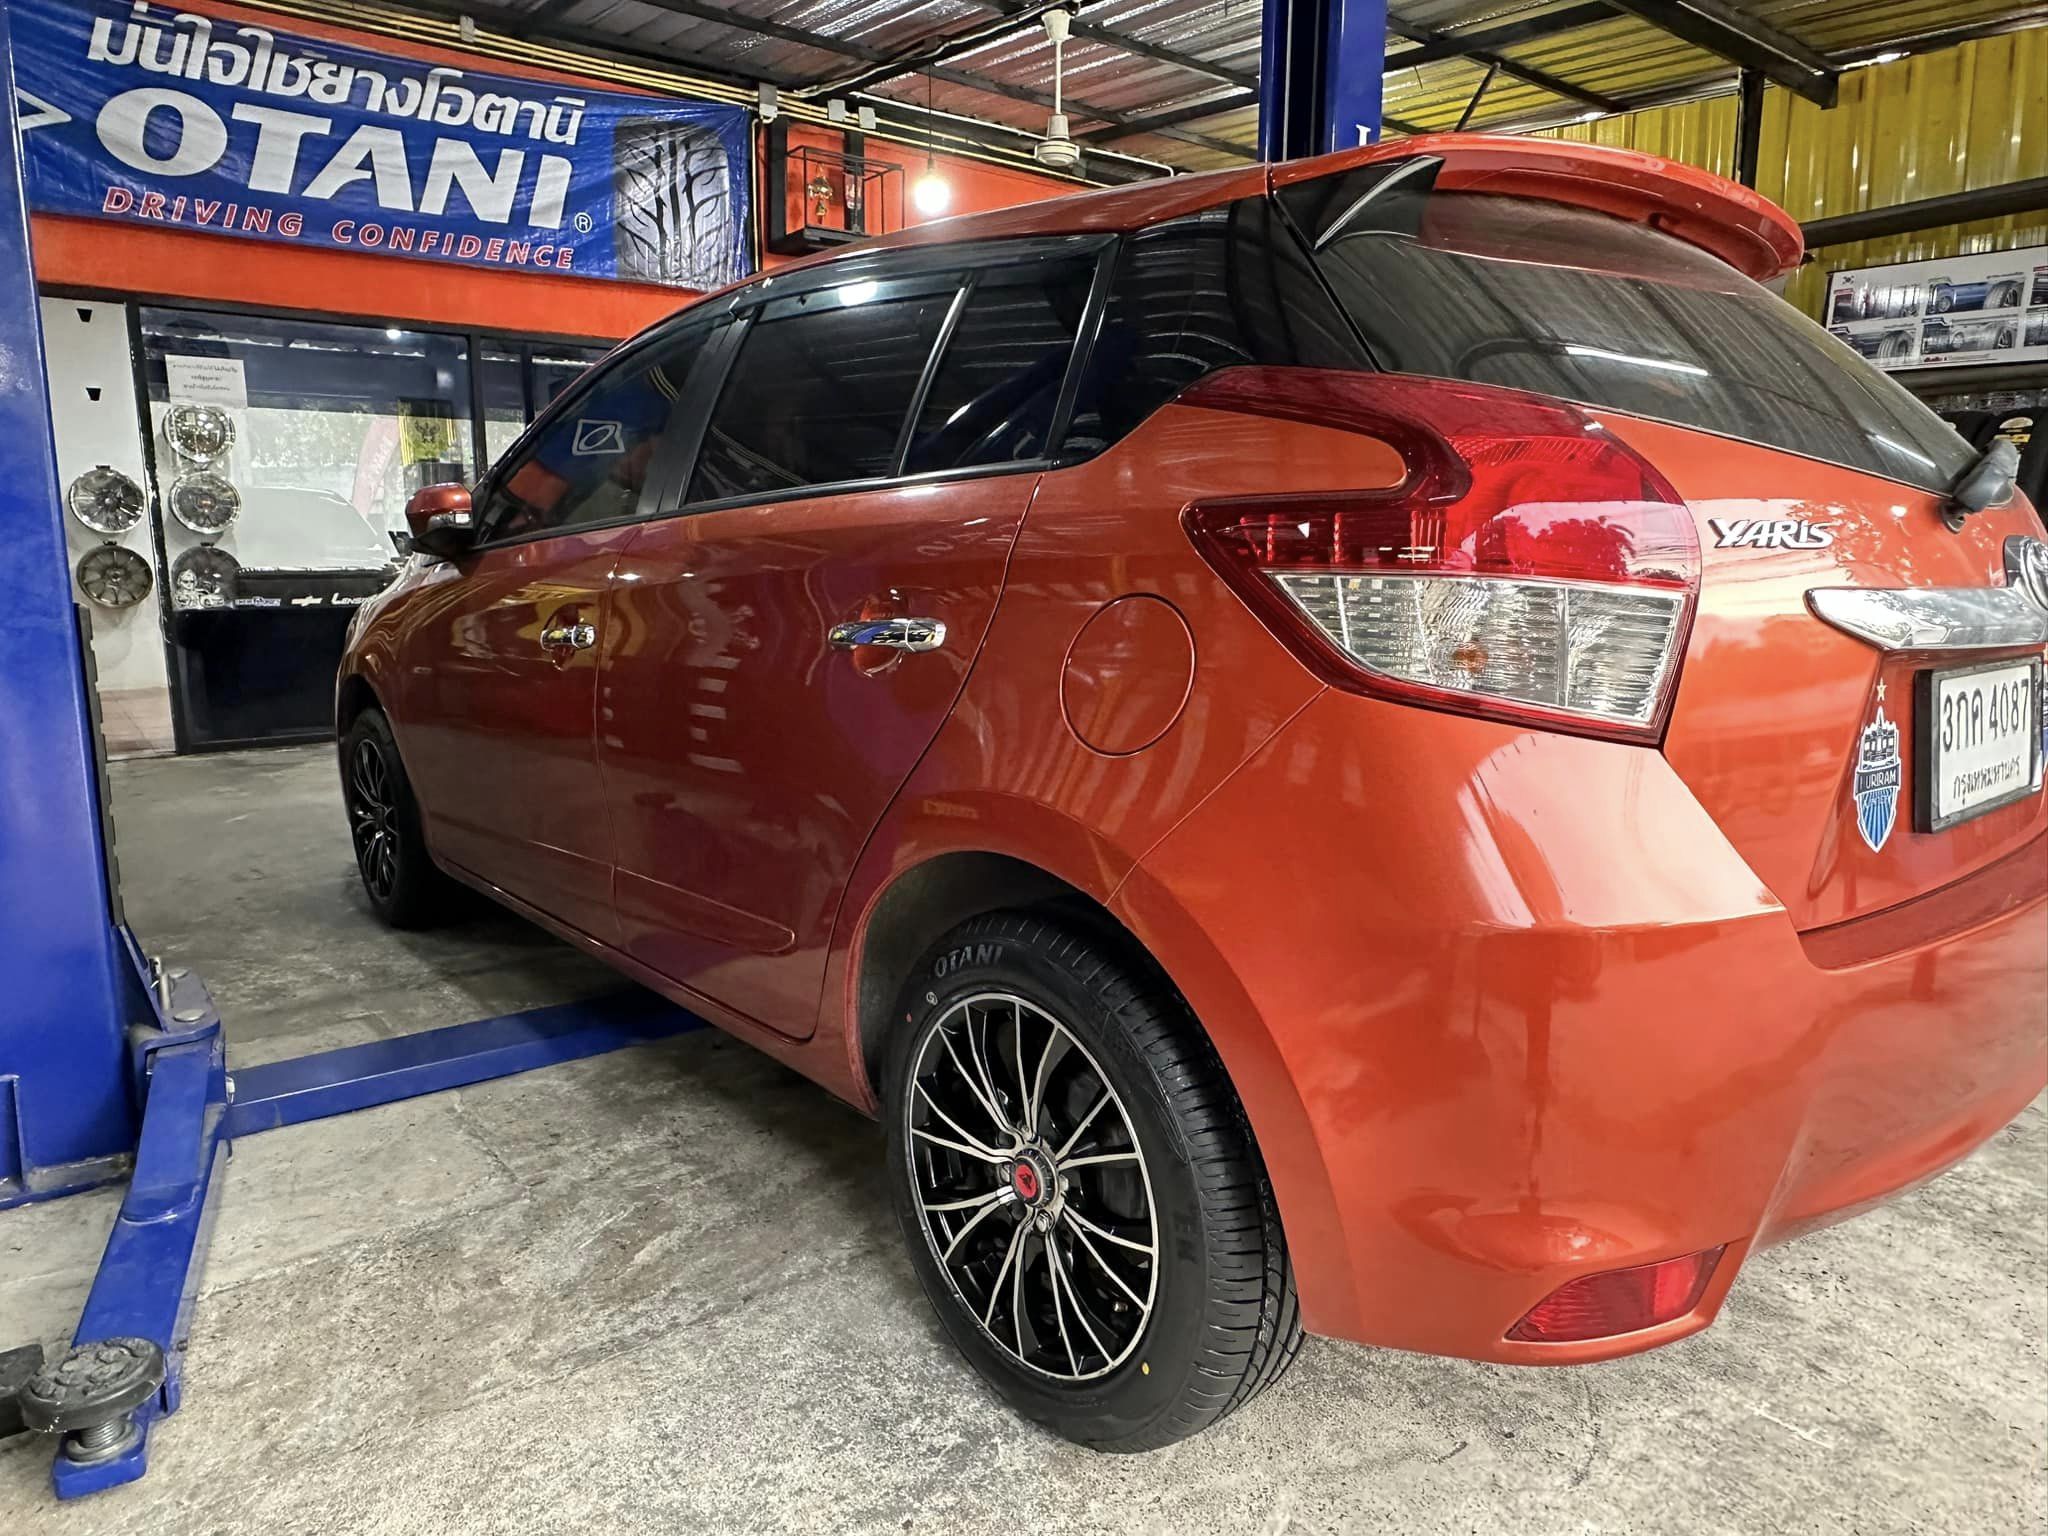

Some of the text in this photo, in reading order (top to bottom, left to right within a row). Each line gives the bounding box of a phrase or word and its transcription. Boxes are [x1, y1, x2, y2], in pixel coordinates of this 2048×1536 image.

[96, 87, 573, 230] OTANI
[103, 187, 574, 269] DRIVING CONFIDENCE
[1708, 518, 1836, 549] YARIS
[1989, 678, 2029, 742] 4087
[935, 944, 1003, 978] OTANI
